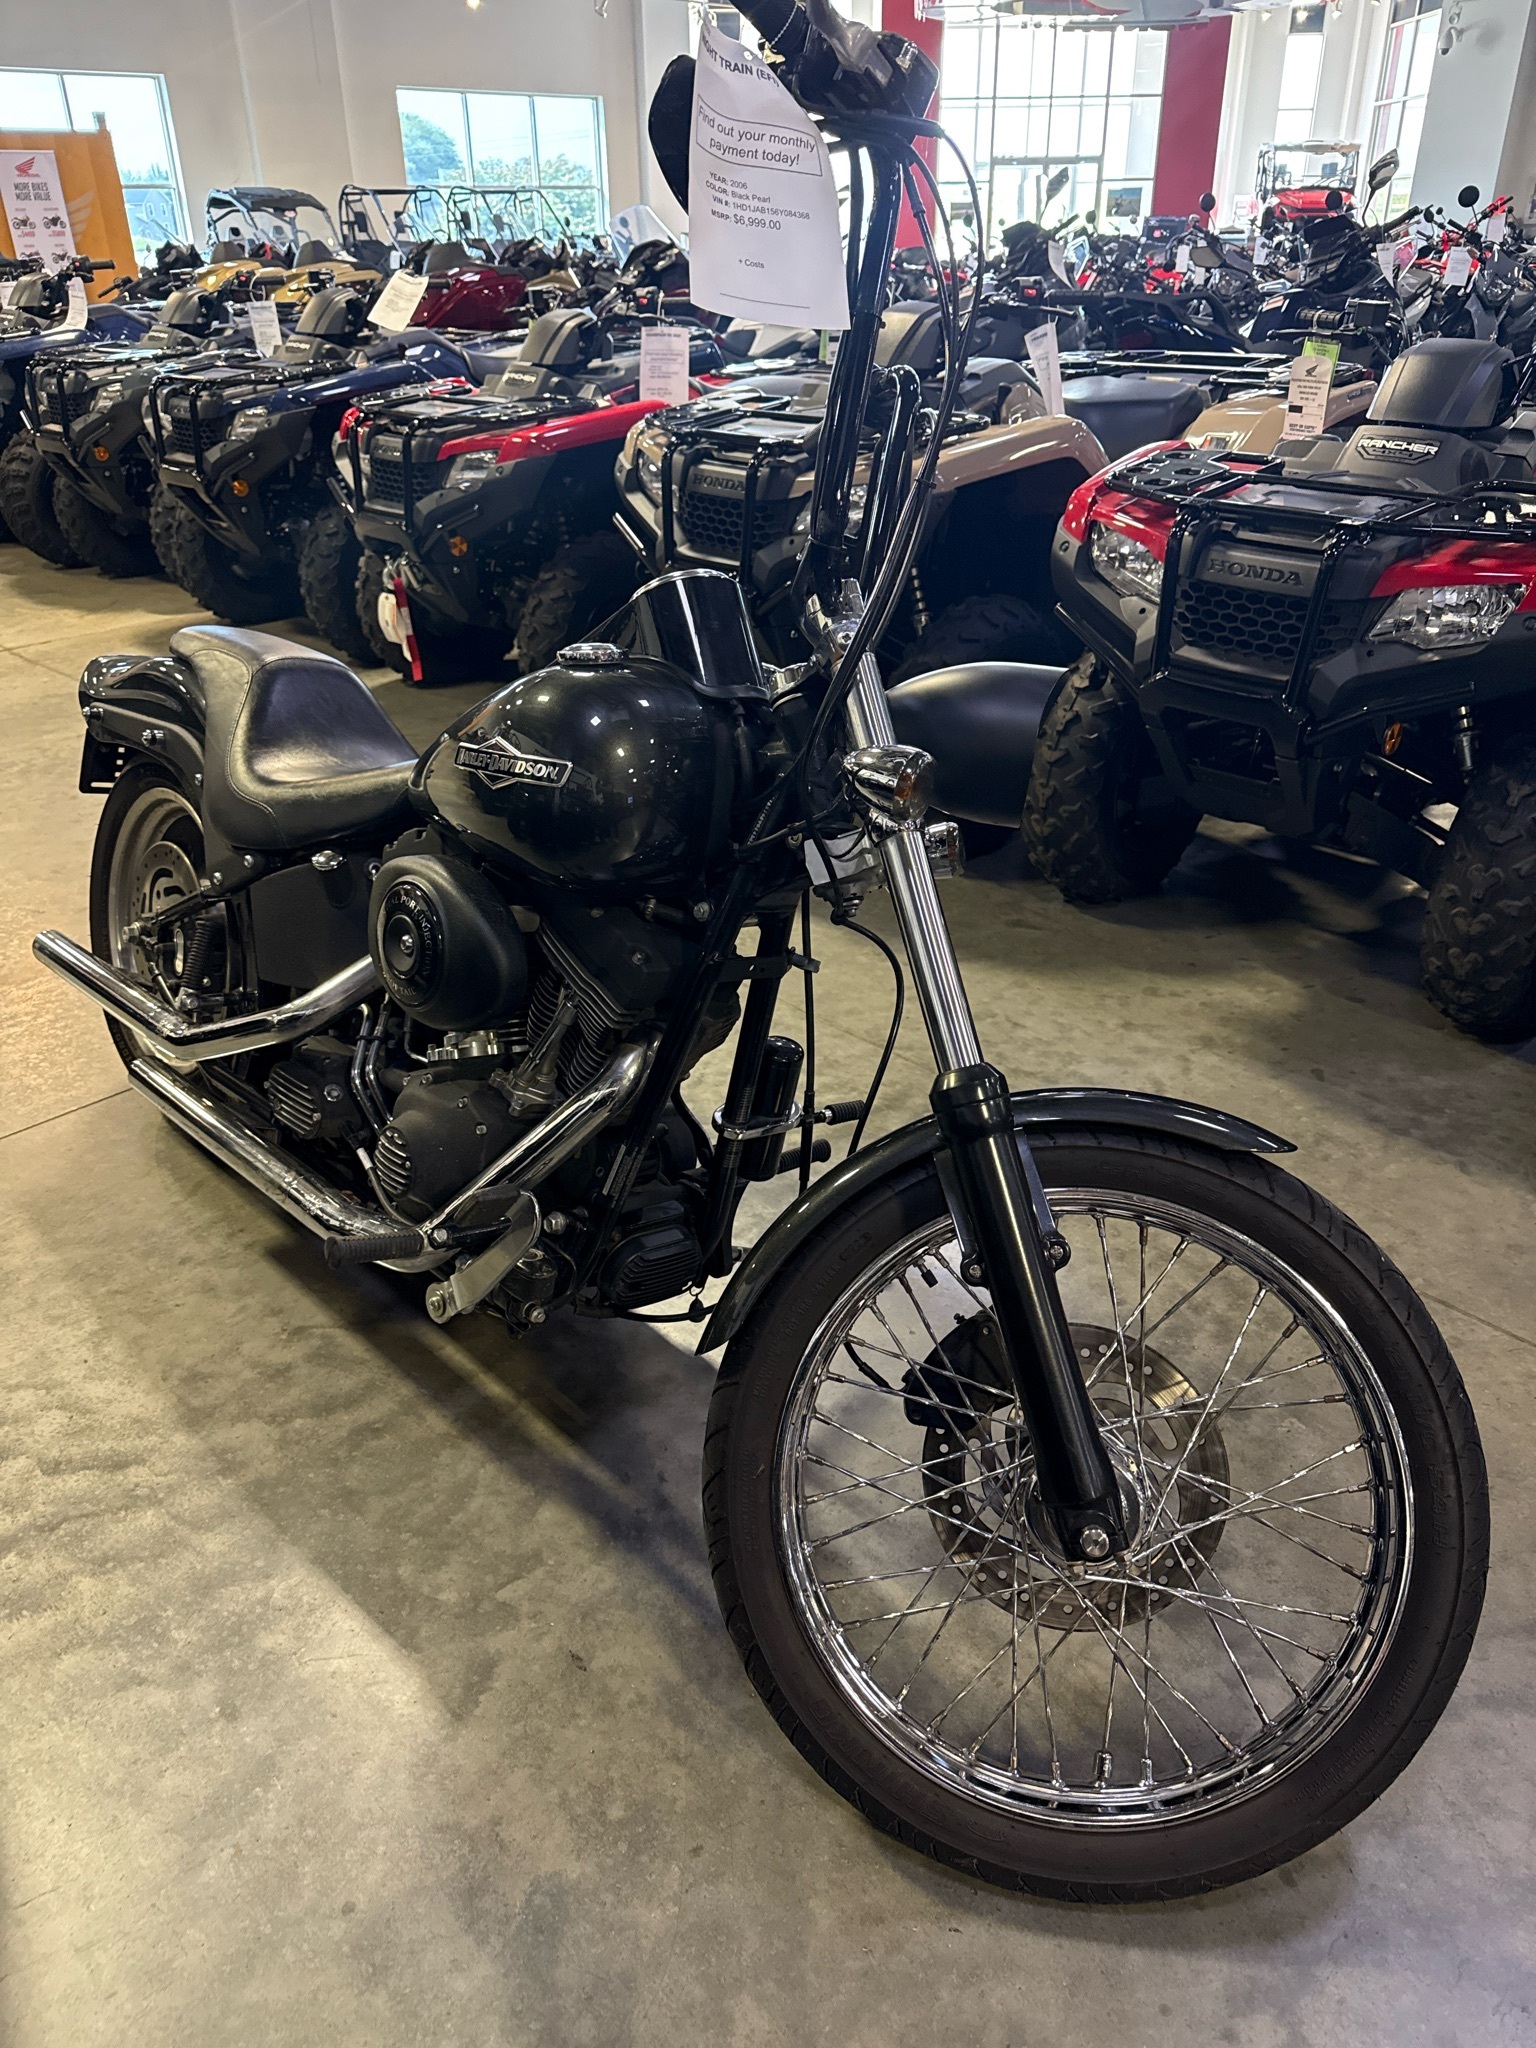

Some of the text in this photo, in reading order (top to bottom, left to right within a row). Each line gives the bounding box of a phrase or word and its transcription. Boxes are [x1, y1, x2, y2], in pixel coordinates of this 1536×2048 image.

[719, 55, 753, 76] TRAIN
[698, 105, 816, 153] Find out your monthly
[709, 137, 800, 167] payment today!
[13, 182, 49, 191] MORE BIKES
[709, 171, 748, 190] YEAR: 2006
[15, 192, 32, 201] MORE
[705, 180, 771, 203] COLOR: Black Pearl
[712, 195, 723, 205] VIN
[711, 209, 781, 231] MSRP: $6,999.00
[744, 258, 765, 269] Costs
[1357, 438, 1439, 455] RANCHER
[692, 473, 745, 492] HONDA
[1207, 558, 1304, 586] HONDA
[400, 895, 420, 913] PORT
